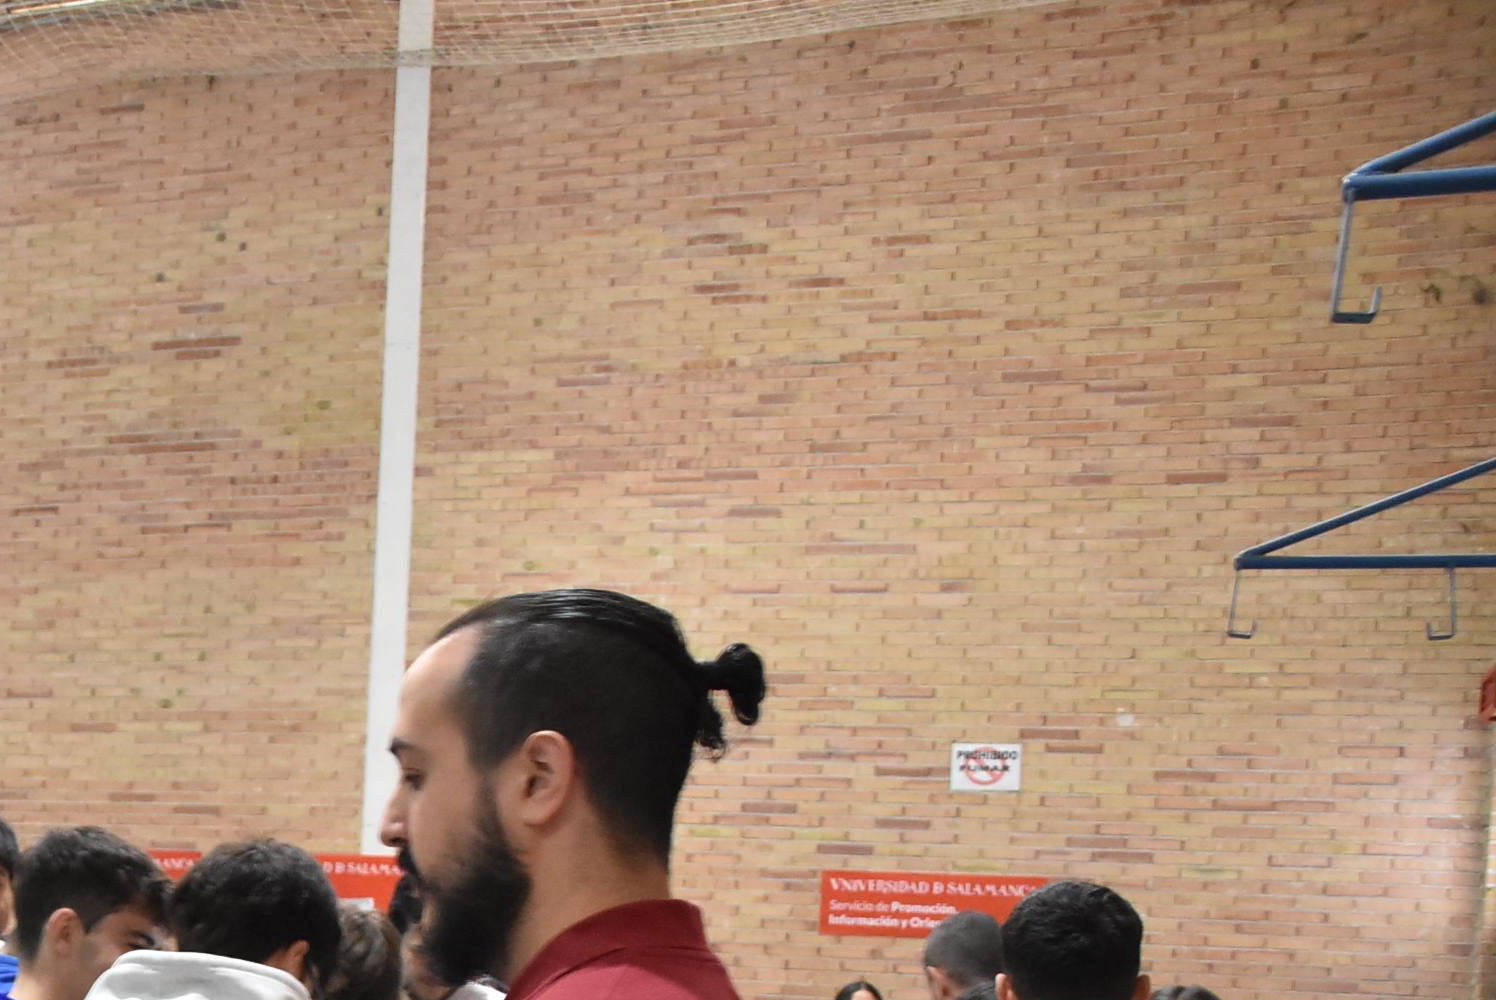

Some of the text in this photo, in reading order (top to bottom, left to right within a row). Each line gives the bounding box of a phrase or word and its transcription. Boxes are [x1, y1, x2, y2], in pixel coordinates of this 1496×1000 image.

[829, 899, 873, 912] Servicio
[874, 902, 889, 913] de
[828, 914, 900, 927] Información
[901, 918, 908, 929] y
